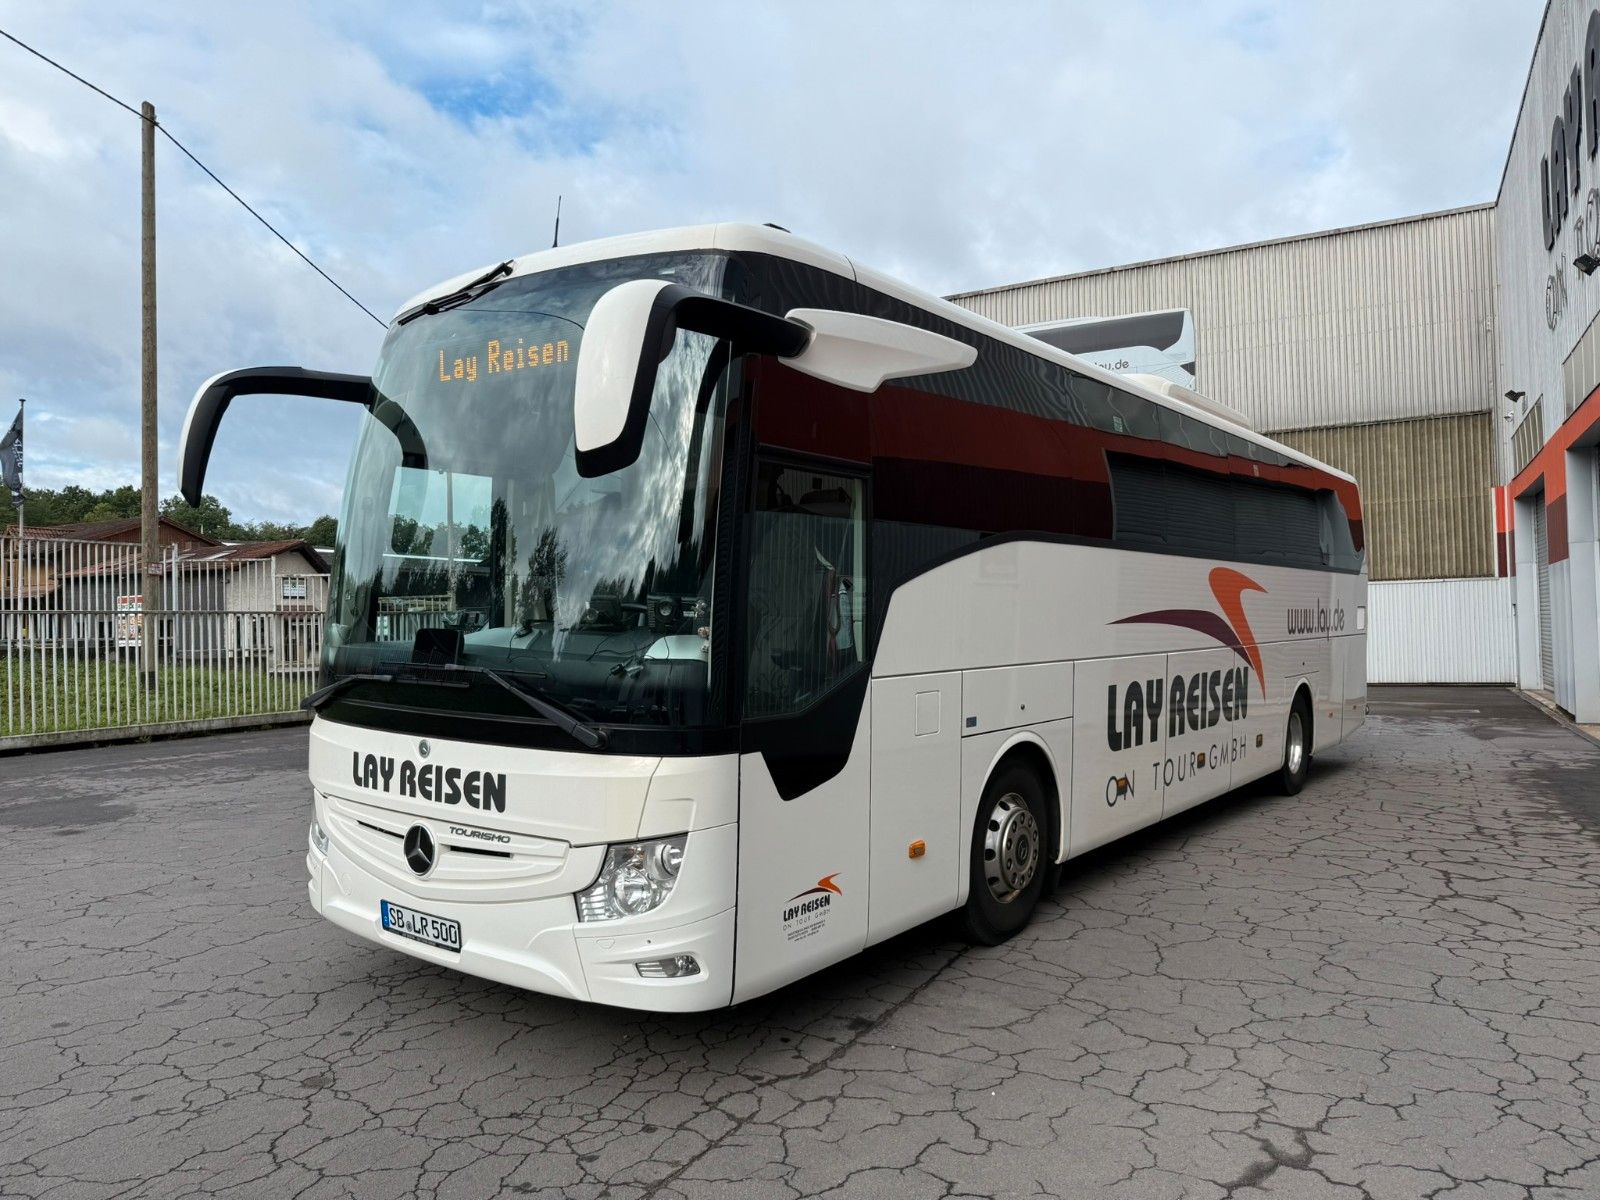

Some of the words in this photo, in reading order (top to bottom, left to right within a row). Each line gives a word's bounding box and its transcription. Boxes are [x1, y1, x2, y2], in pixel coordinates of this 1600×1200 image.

[1540, 61, 1581, 251] LAY
[440, 350, 477, 382] Lay
[488, 338, 569, 374] Reisen
[1287, 597, 1345, 642] www.lay.de
[1107, 678, 1163, 752] LAY
[1169, 666, 1249, 738] REISEN
[353, 751, 394, 793] LAY
[400, 760, 507, 813] REISEN
[1106, 769, 1135, 807] ON
[1153, 751, 1196, 791] TOUR
[1209, 734, 1247, 770] GMBH
[449, 826, 511, 844] TOURISMO
[389, 907, 405, 928] SB
[412, 914, 430, 938] LR
[431, 920, 458, 944] 500
[783, 905, 800, 922] LAY
[801, 894, 831, 916] REISEN
